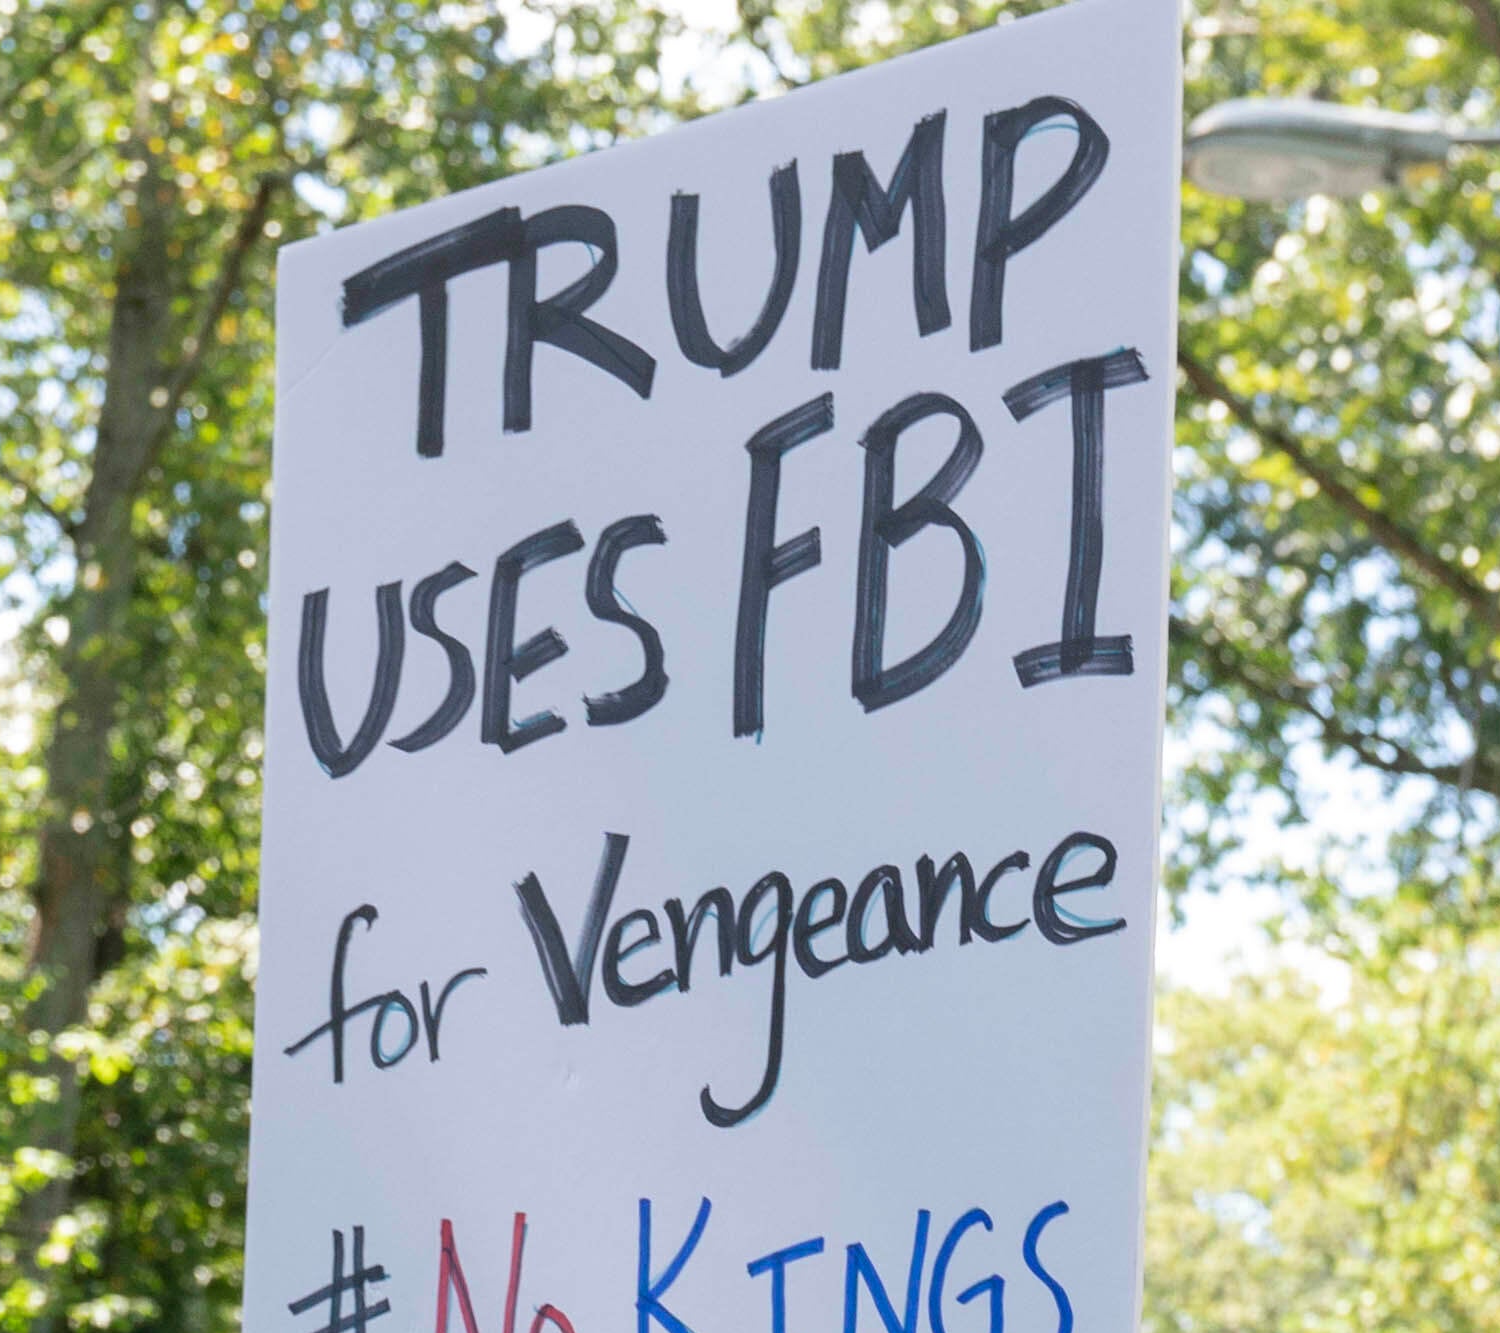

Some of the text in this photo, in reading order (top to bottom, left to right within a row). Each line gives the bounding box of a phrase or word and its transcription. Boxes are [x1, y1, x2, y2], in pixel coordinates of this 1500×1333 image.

[342, 95, 1110, 459] TRUMP
[299, 346, 1150, 779] USES FBI
[284, 831, 1127, 1128] for Vengeance
